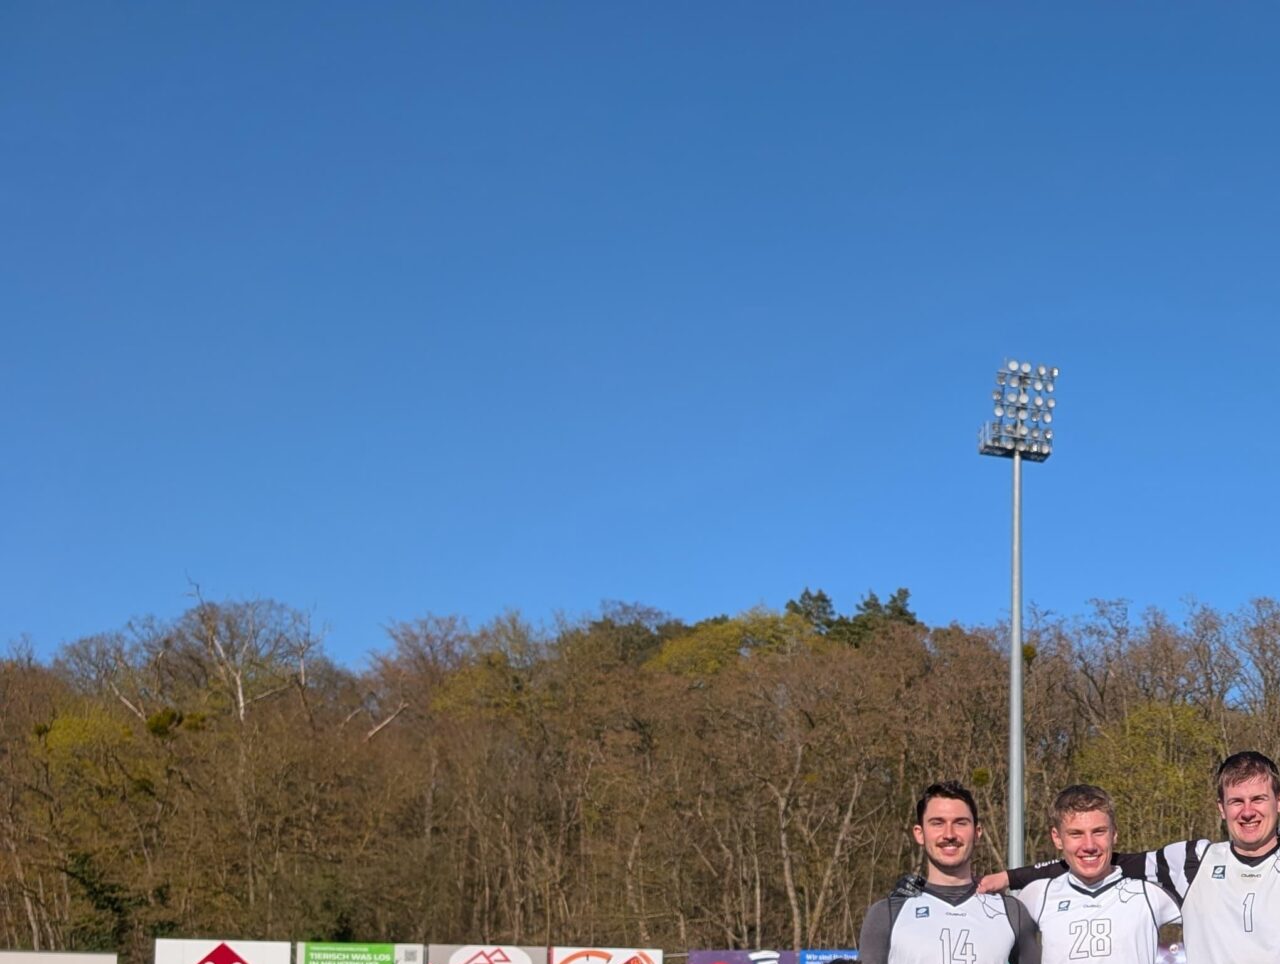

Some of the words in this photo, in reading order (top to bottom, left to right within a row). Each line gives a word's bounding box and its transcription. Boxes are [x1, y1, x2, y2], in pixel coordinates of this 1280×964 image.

[1242, 893, 1256, 932] 1
[310, 952, 349, 960] TIERISCH
[351, 953, 372, 961] WAS
[373, 954, 391, 962] LOS
[1069, 919, 1111, 960] 28
